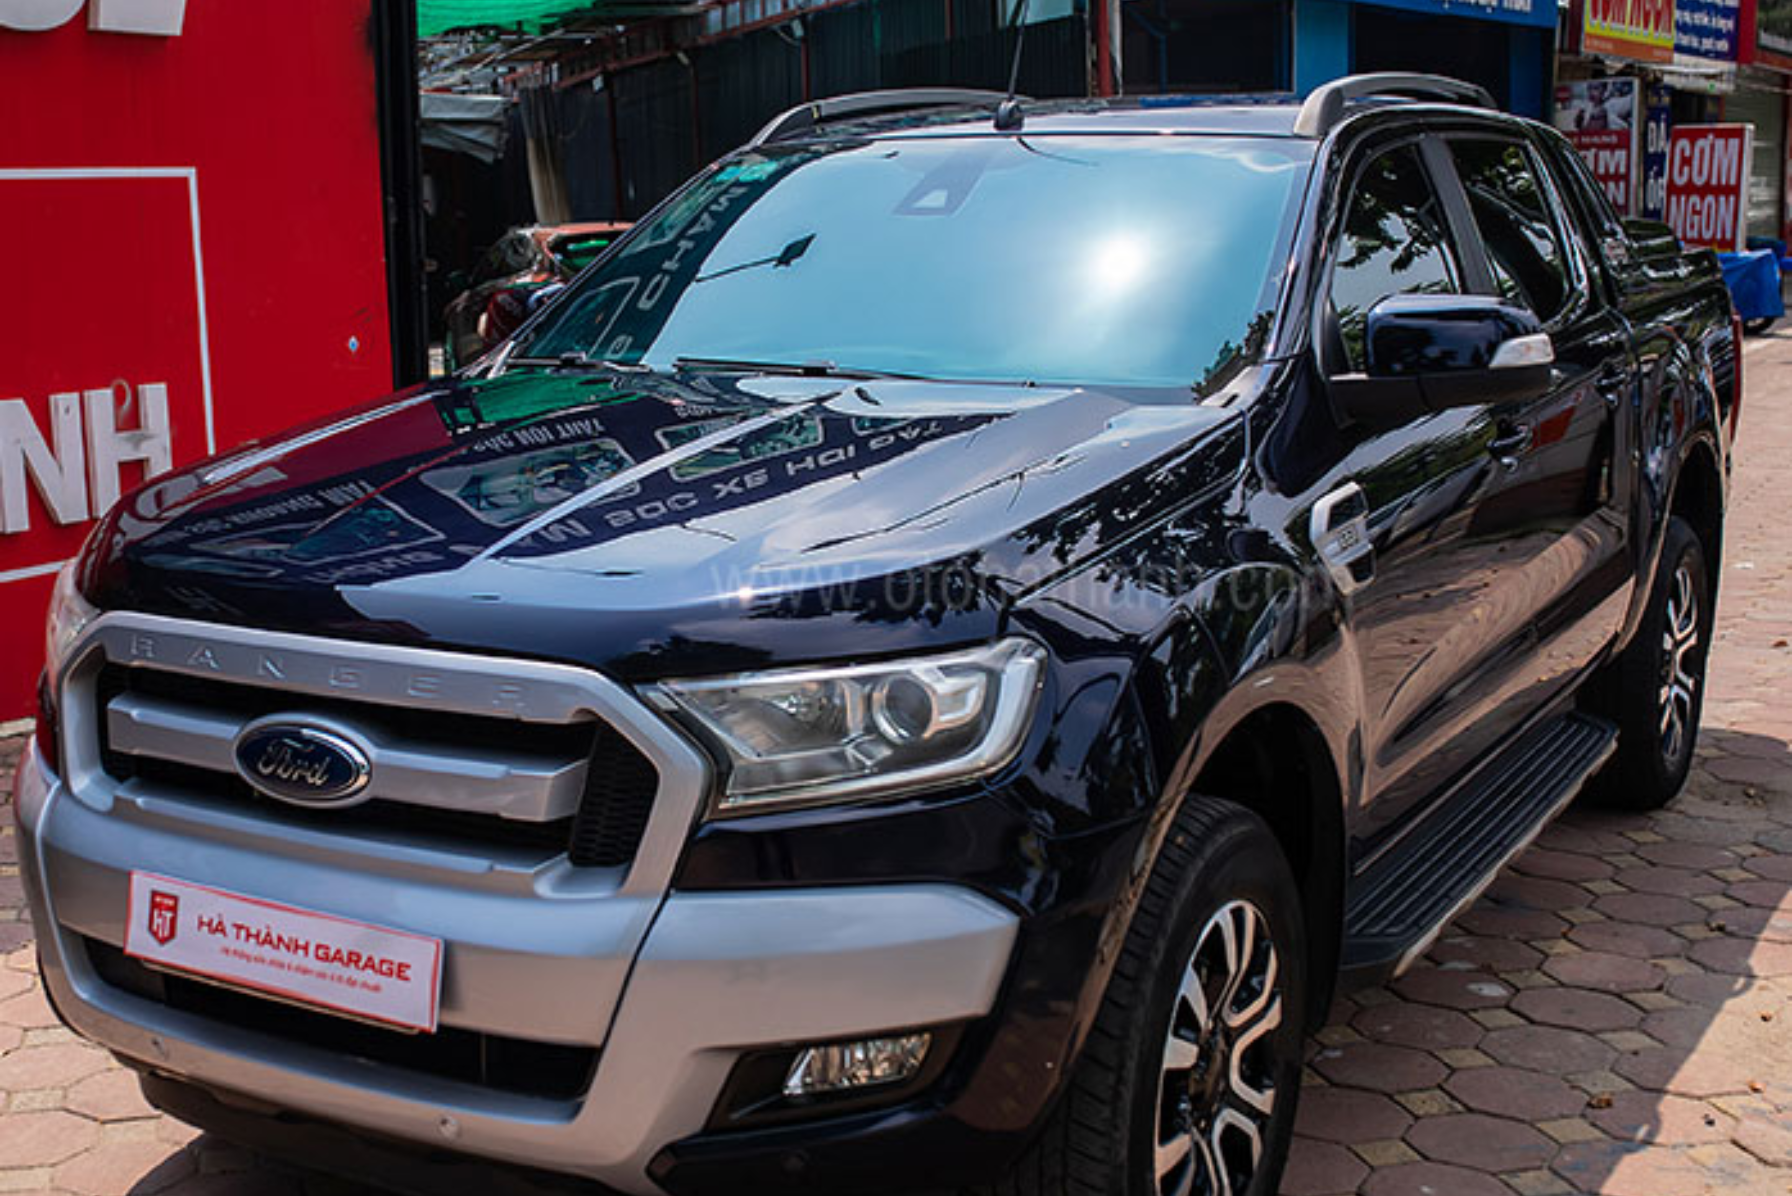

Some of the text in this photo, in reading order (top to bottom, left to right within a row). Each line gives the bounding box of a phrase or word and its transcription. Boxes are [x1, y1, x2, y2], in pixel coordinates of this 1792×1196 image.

[1672, 133, 1741, 186] CƠM
[1669, 193, 1737, 241] NGON
[129, 632, 527, 709] RANGER
[256, 735, 331, 787] Ford
[196, 912, 228, 938] HÀ
[231, 921, 310, 957] THÀNH
[313, 943, 412, 982] GARAGE
